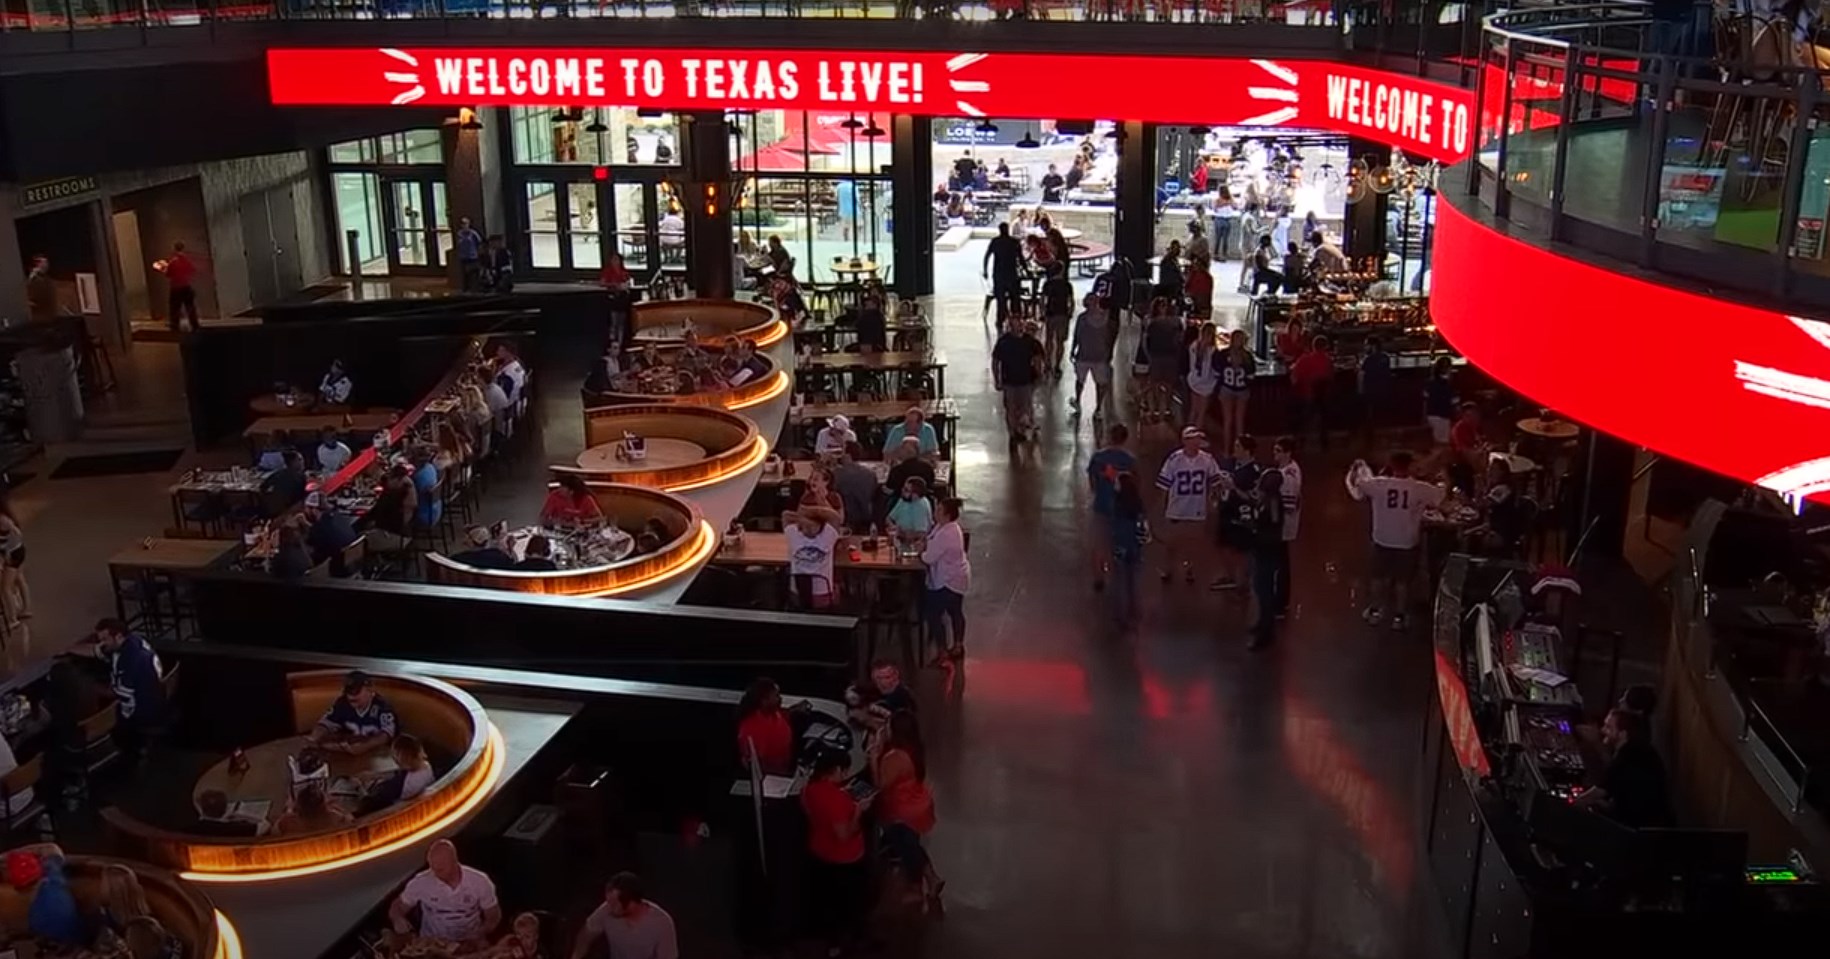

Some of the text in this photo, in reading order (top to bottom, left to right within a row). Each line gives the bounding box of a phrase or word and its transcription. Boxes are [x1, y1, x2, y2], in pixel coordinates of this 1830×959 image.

[434, 58, 923, 103] WELCOME TO TEXAS LIVE!
[1327, 74, 1468, 153] WELCOME TO
[27, 176, 96, 201] RESTROOMS
[1177, 470, 1205, 495] 22
[1387, 489, 1408, 509] 21
